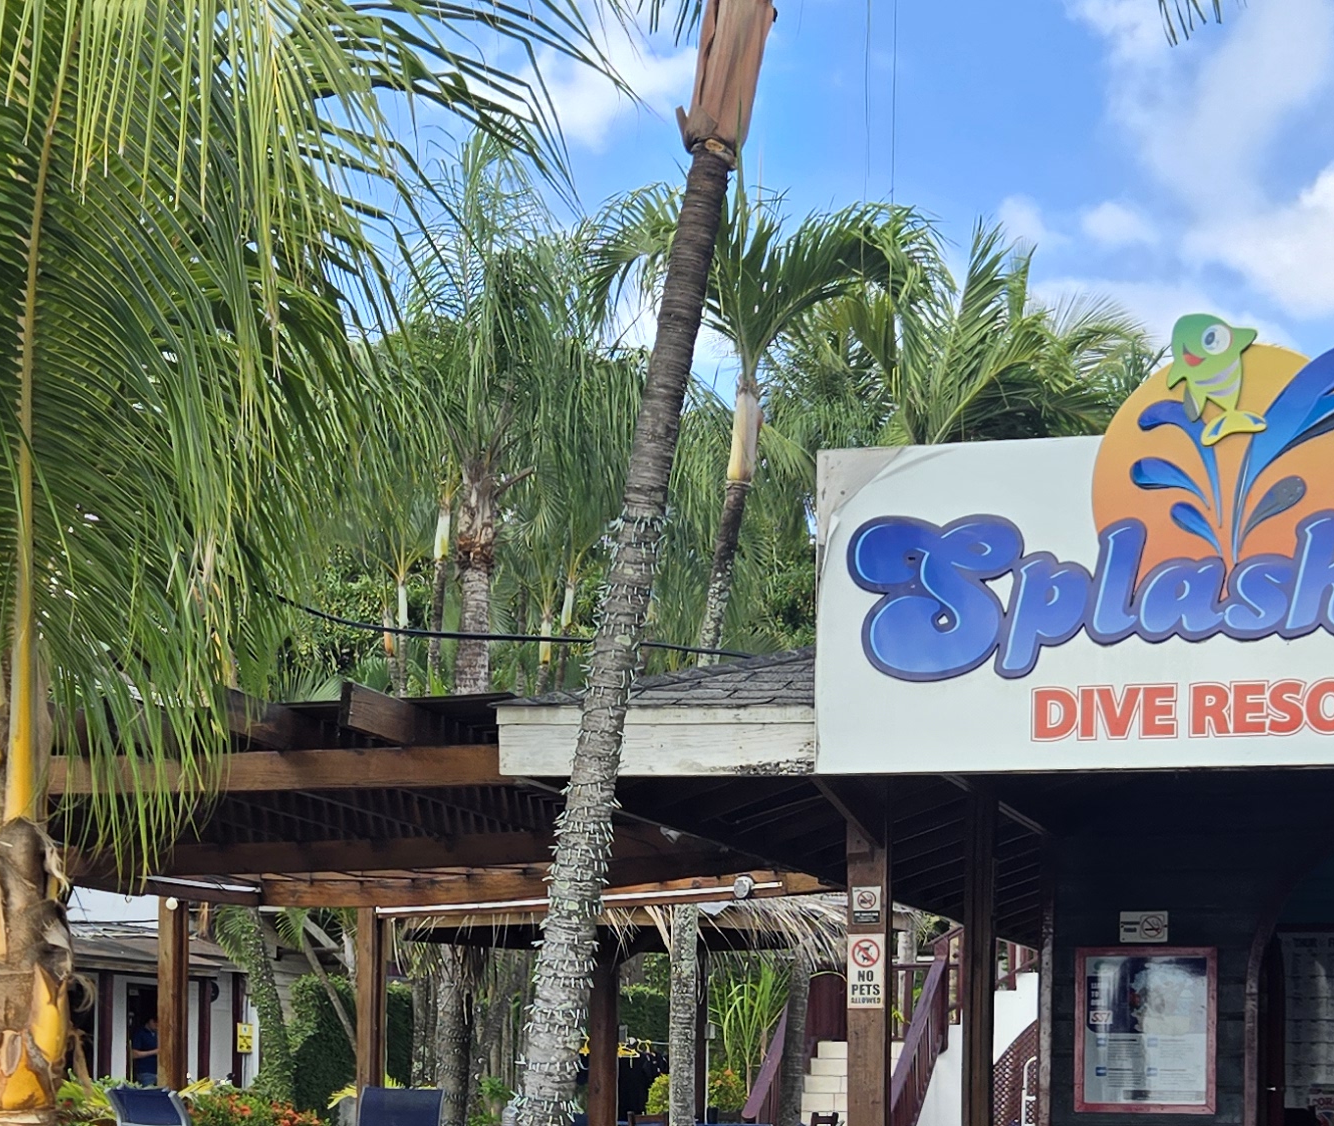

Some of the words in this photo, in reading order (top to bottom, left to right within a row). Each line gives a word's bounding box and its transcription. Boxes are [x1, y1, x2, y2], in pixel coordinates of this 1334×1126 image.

[1031, 682, 1178, 742] DIVE
[857, 970, 874, 982] NO
[851, 984, 880, 996] PETS
[851, 996, 881, 1004] ALLOWED
